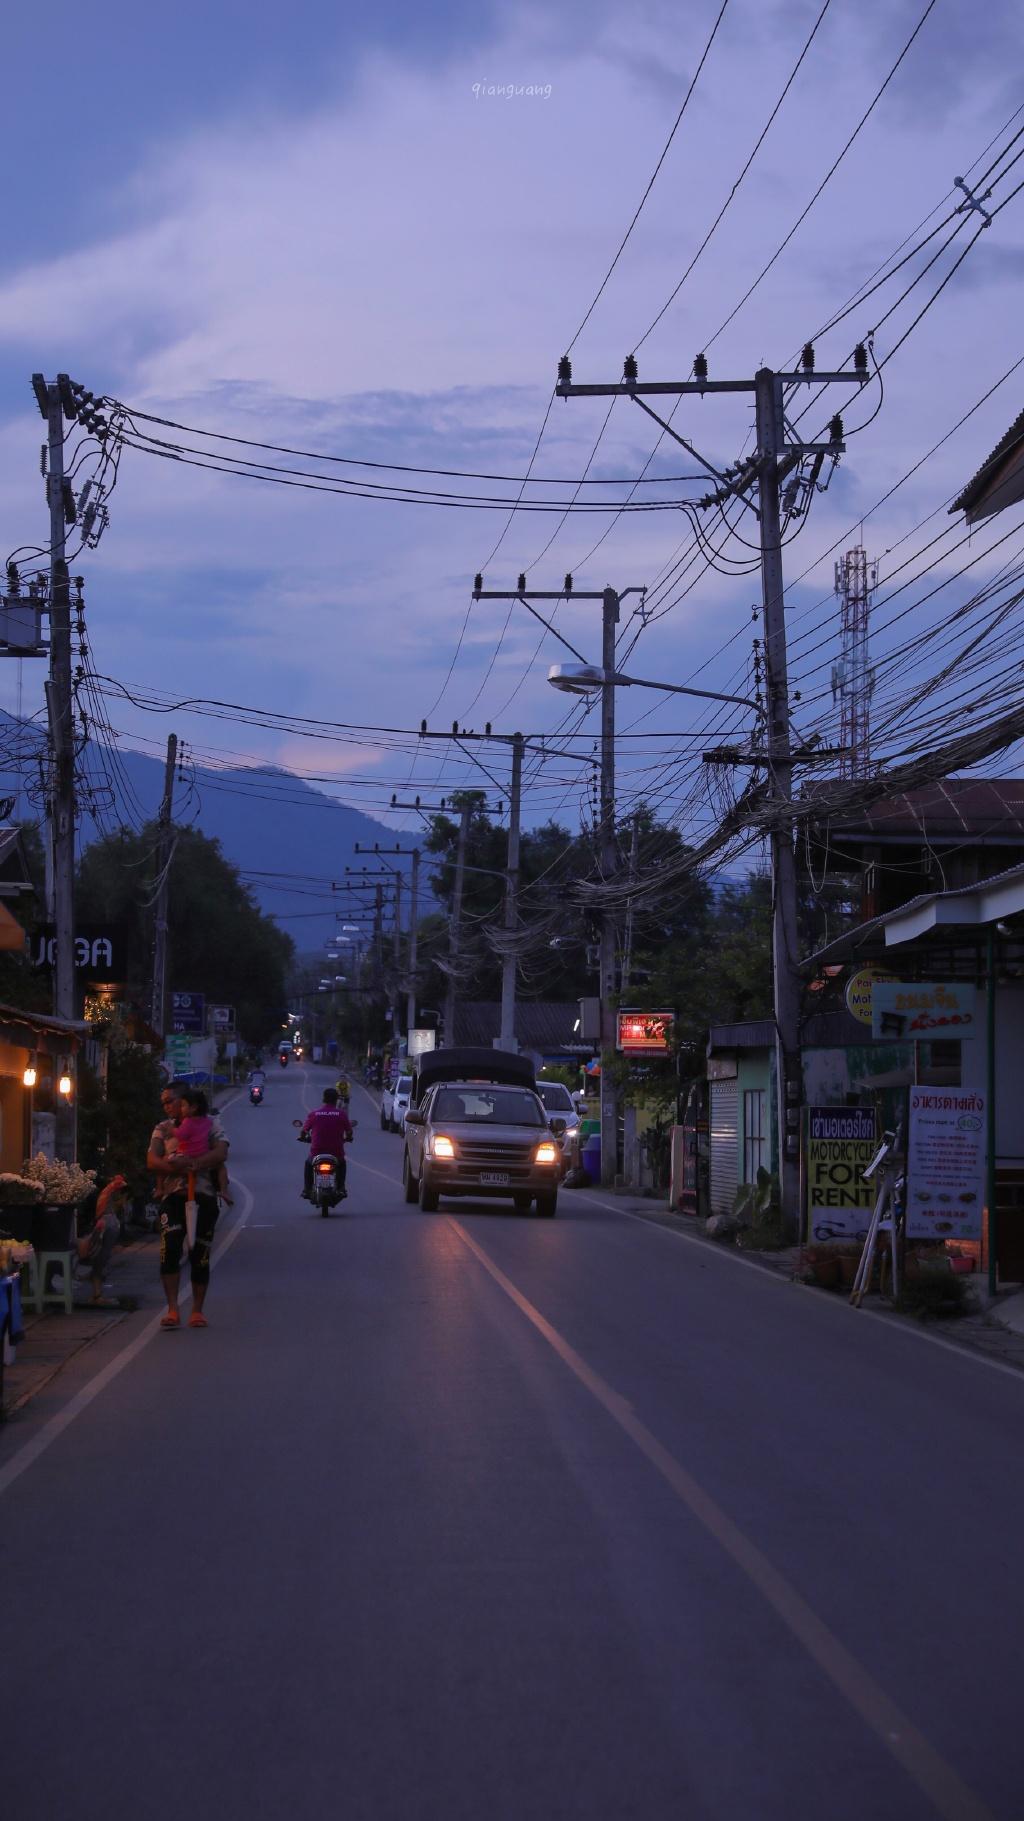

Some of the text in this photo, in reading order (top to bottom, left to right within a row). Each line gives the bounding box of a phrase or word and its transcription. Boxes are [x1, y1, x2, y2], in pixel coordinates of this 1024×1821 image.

[912, 1092, 984, 1112] อาหารตามสั่ง
[816, 1163, 871, 1185] FOR
[812, 1188, 874, 1206] RENT
